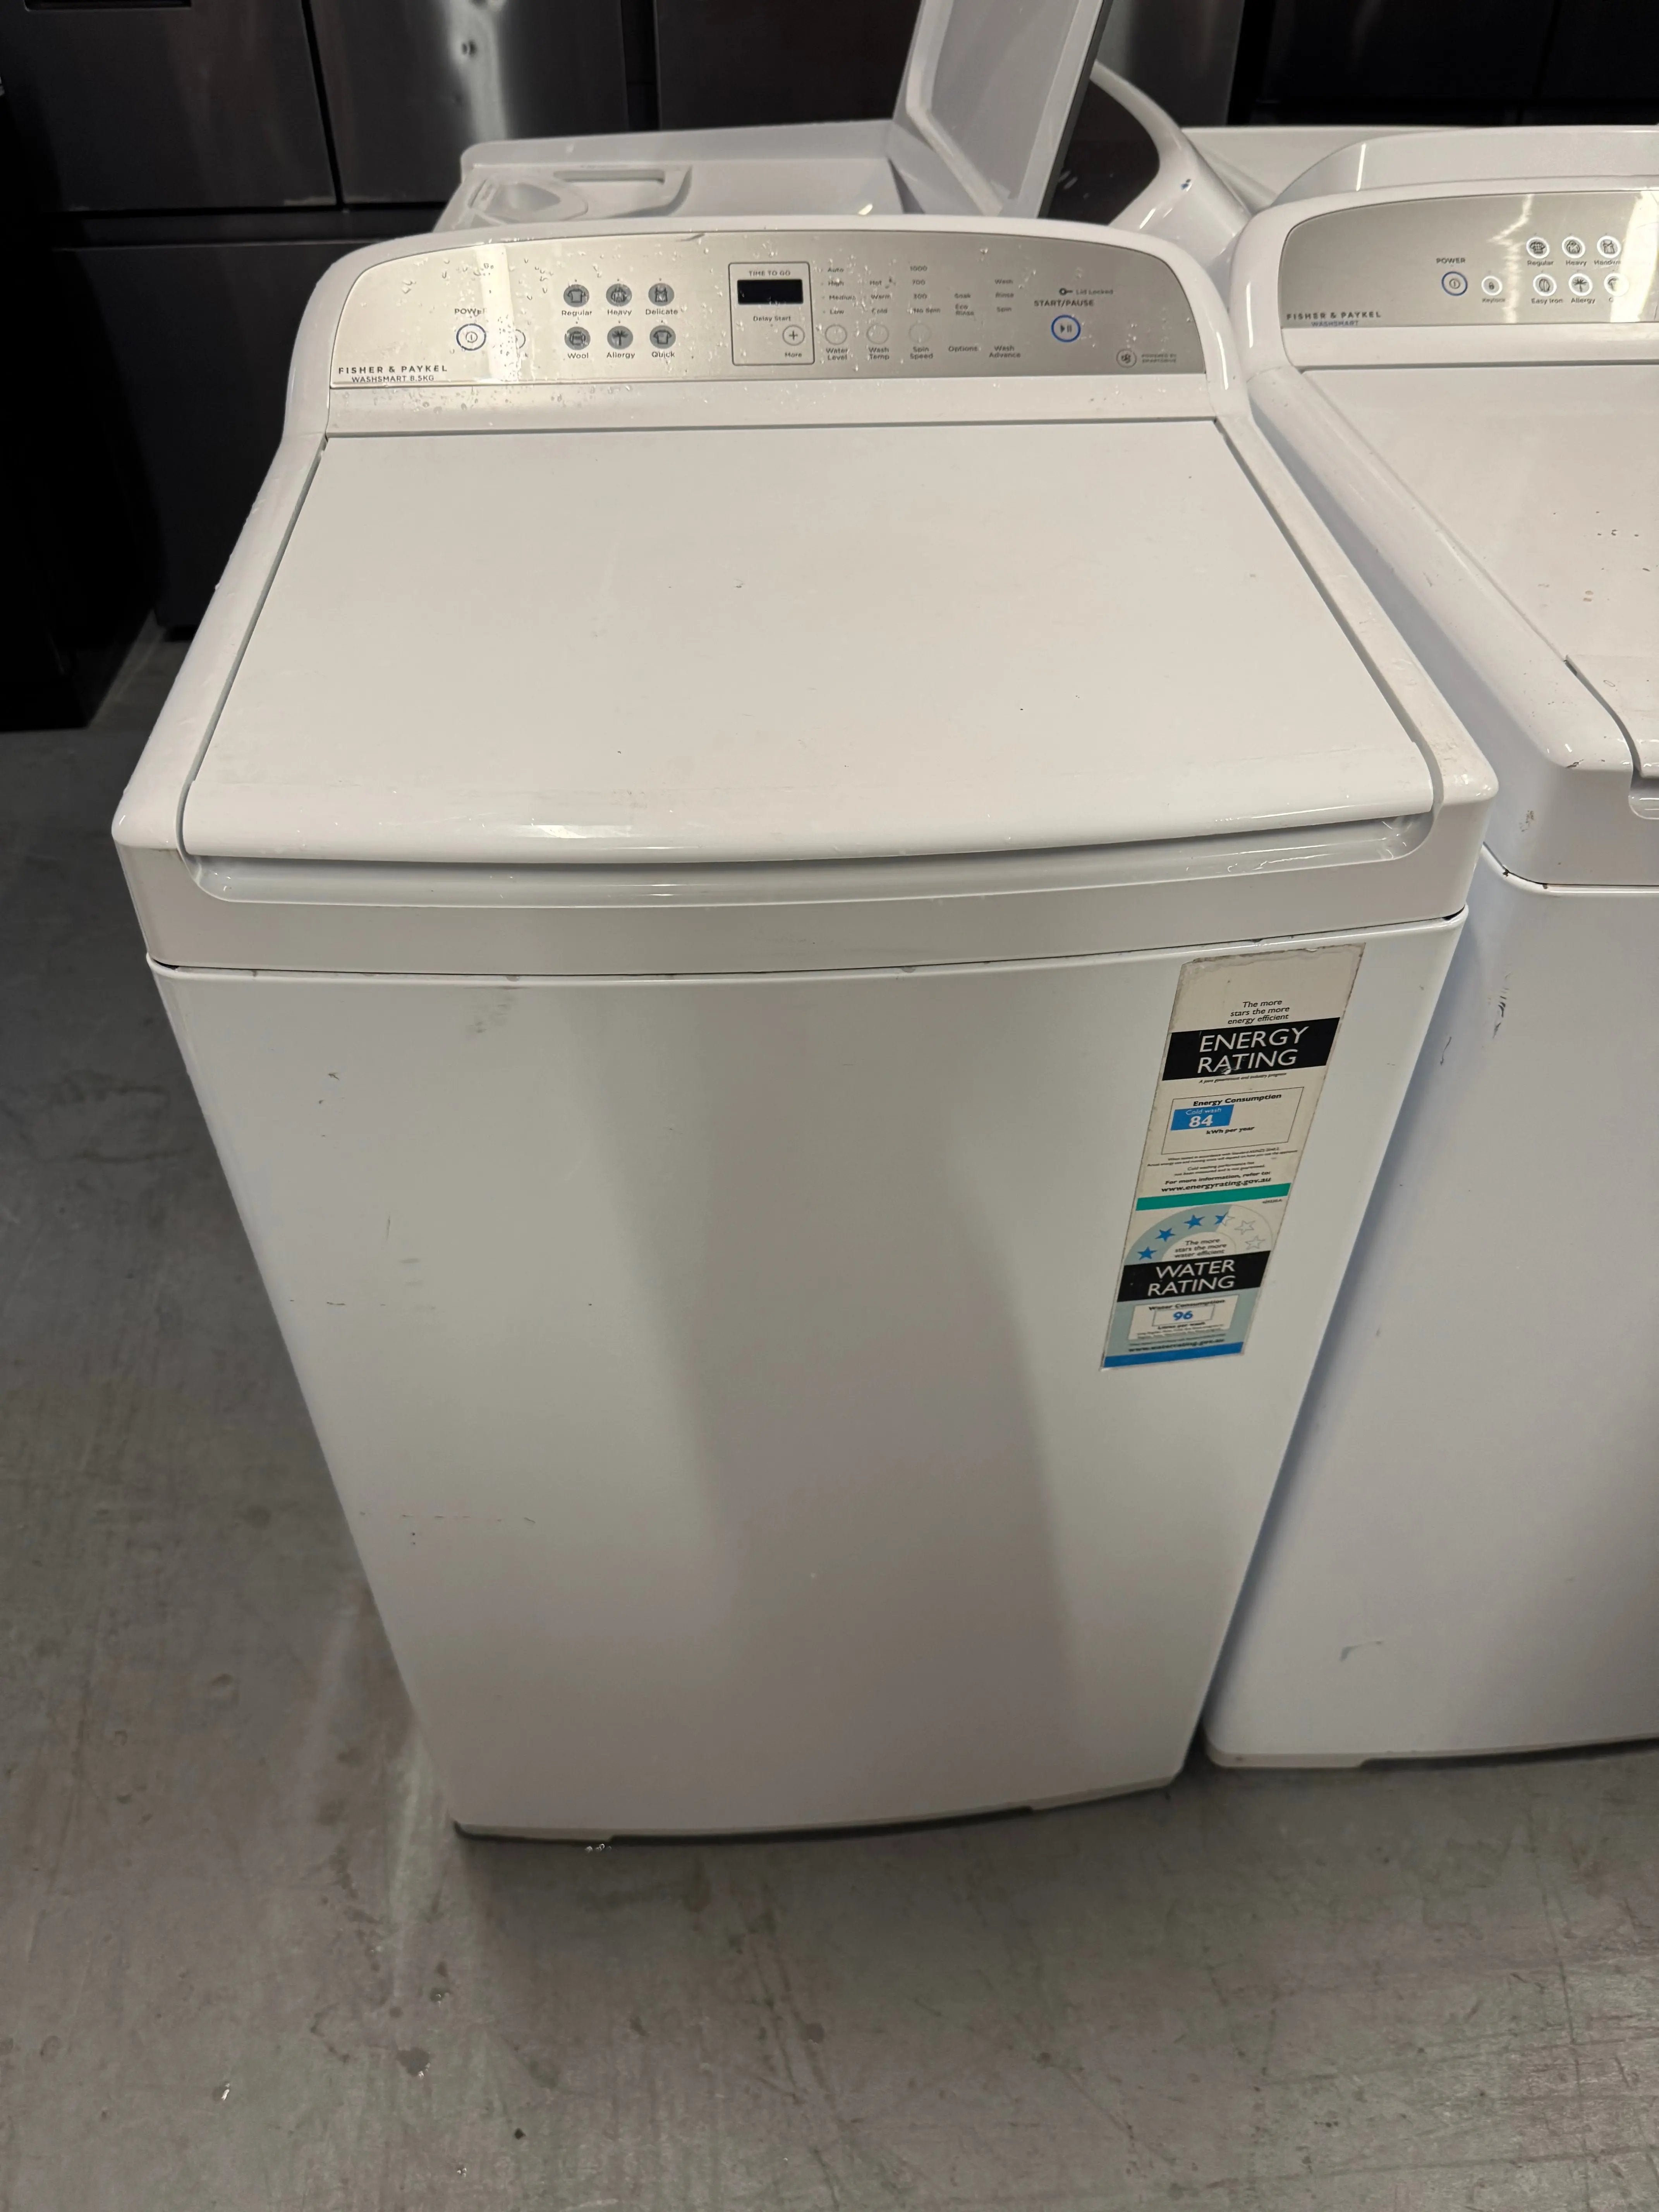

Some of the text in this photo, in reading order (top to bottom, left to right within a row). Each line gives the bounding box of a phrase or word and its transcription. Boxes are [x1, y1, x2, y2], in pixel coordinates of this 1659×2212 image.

[1034, 299, 1096, 308] START/PAUSE
[1286, 312, 1326, 320] FISHER
[338, 366, 383, 374] FISHER
[401, 365, 448, 373] PAYKEL
[1230, 1006, 1290, 1017] stars the more
[1242, 1001, 1259, 1009] The
[1227, 1013, 1289, 1025] energy efficient
[1199, 1025, 1310, 1053] ENERGY
[1197, 1048, 1298, 1074] RATING
[1193, 1092, 1282, 1107] Energy Consumption
[1188, 1114, 1213, 1128] 84
[1161, 1177, 1272, 1192] www.energyrating.gov.au
[1156, 1259, 1237, 1279] WATER
[1147, 1275, 1237, 1297] RATING
[1173, 1310, 1194, 1321] 96
